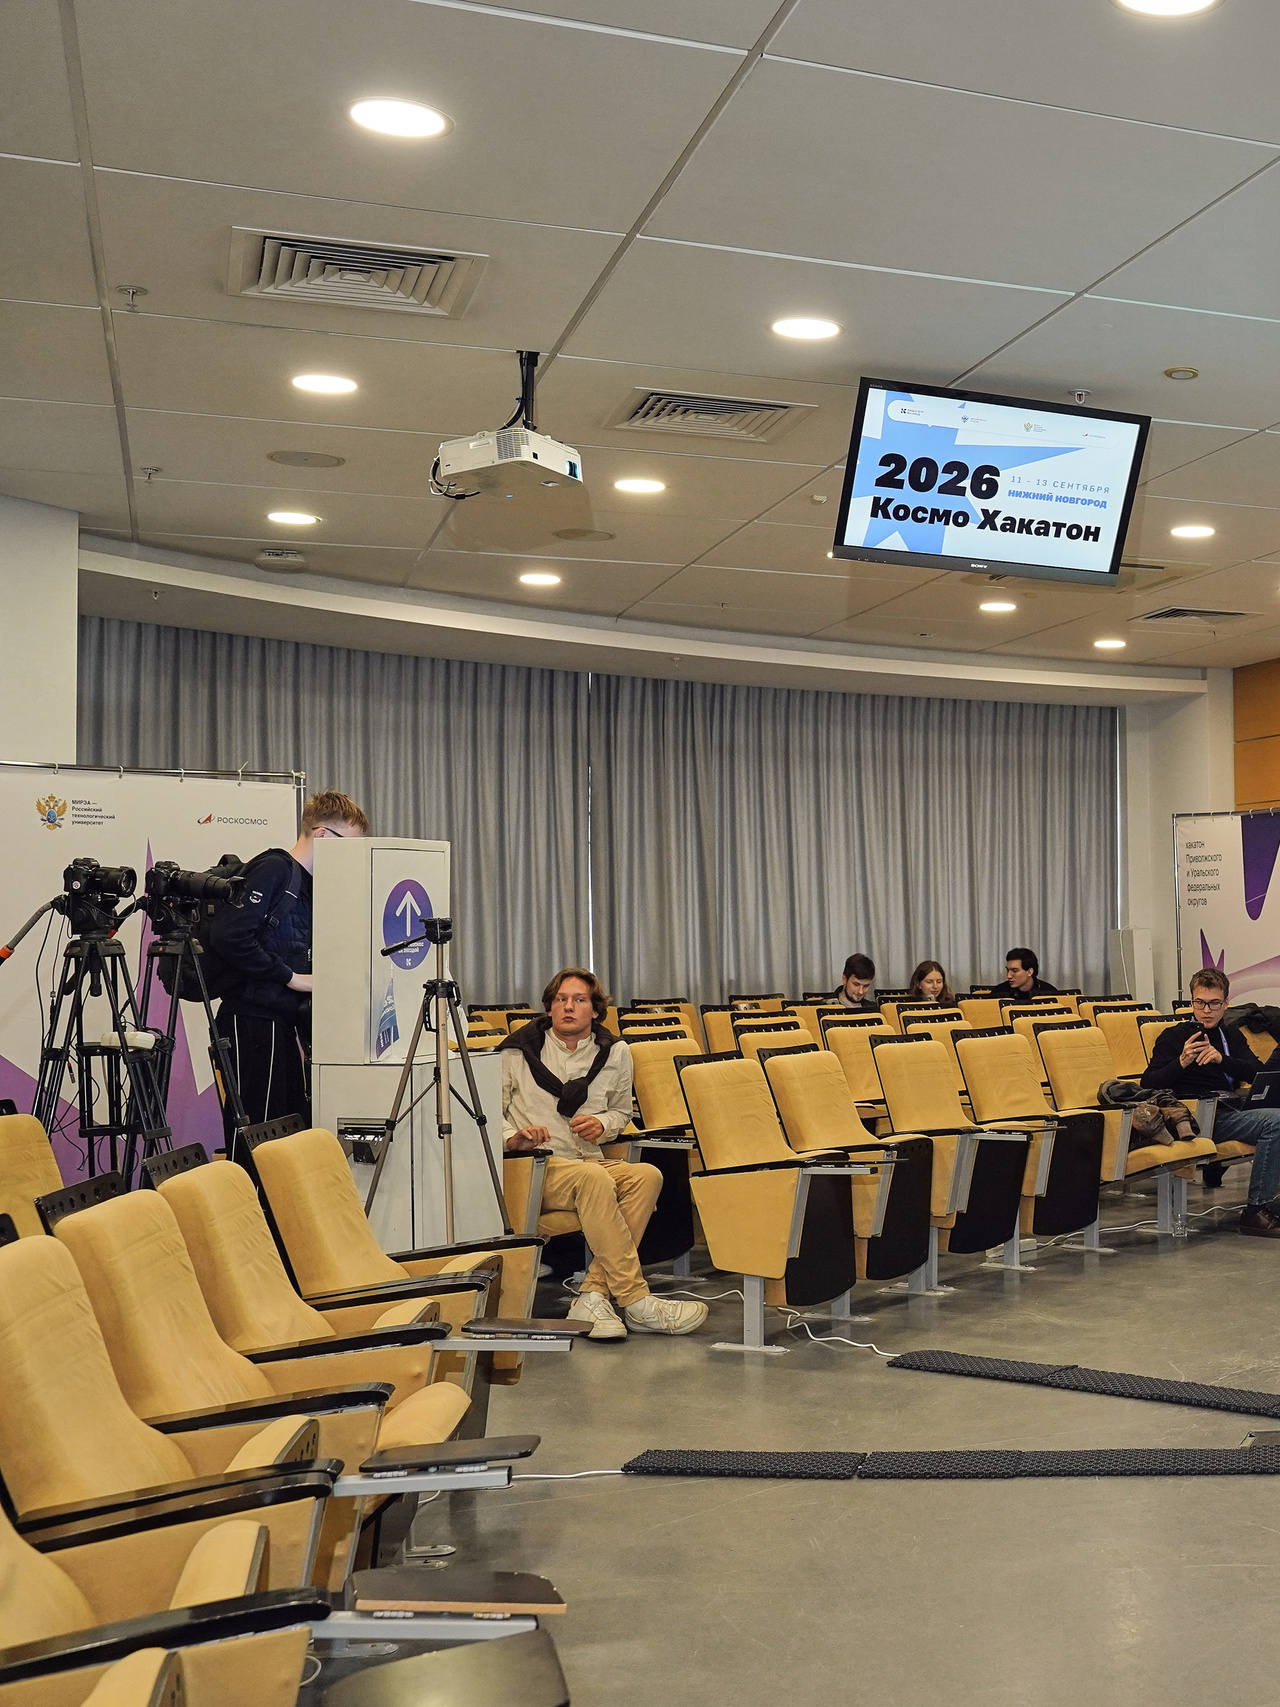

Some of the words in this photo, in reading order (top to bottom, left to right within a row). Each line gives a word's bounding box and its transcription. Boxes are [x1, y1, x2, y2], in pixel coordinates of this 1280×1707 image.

[874, 452, 1000, 500] 2026
[1010, 476, 1022, 484] 11
[1036, 478, 1048, 486] 13
[1052, 480, 1110, 494] СЕНТЯБРЯ
[1008, 490, 1054, 502] НИЖНИЙ
[1054, 495, 1108, 509] НОВГОРОД
[870, 496, 970, 528] Космо
[976, 508, 1101, 542] Хакатон
[217, 817, 268, 826] РОСКОСМОС
[1186, 840, 1205, 849] хакатон
[1186, 854, 1222, 865] Приволжского
[1190, 868, 1220, 879] Уральского
[1187, 883, 1220, 893] федеральных
[1187, 898, 1208, 908] округов
